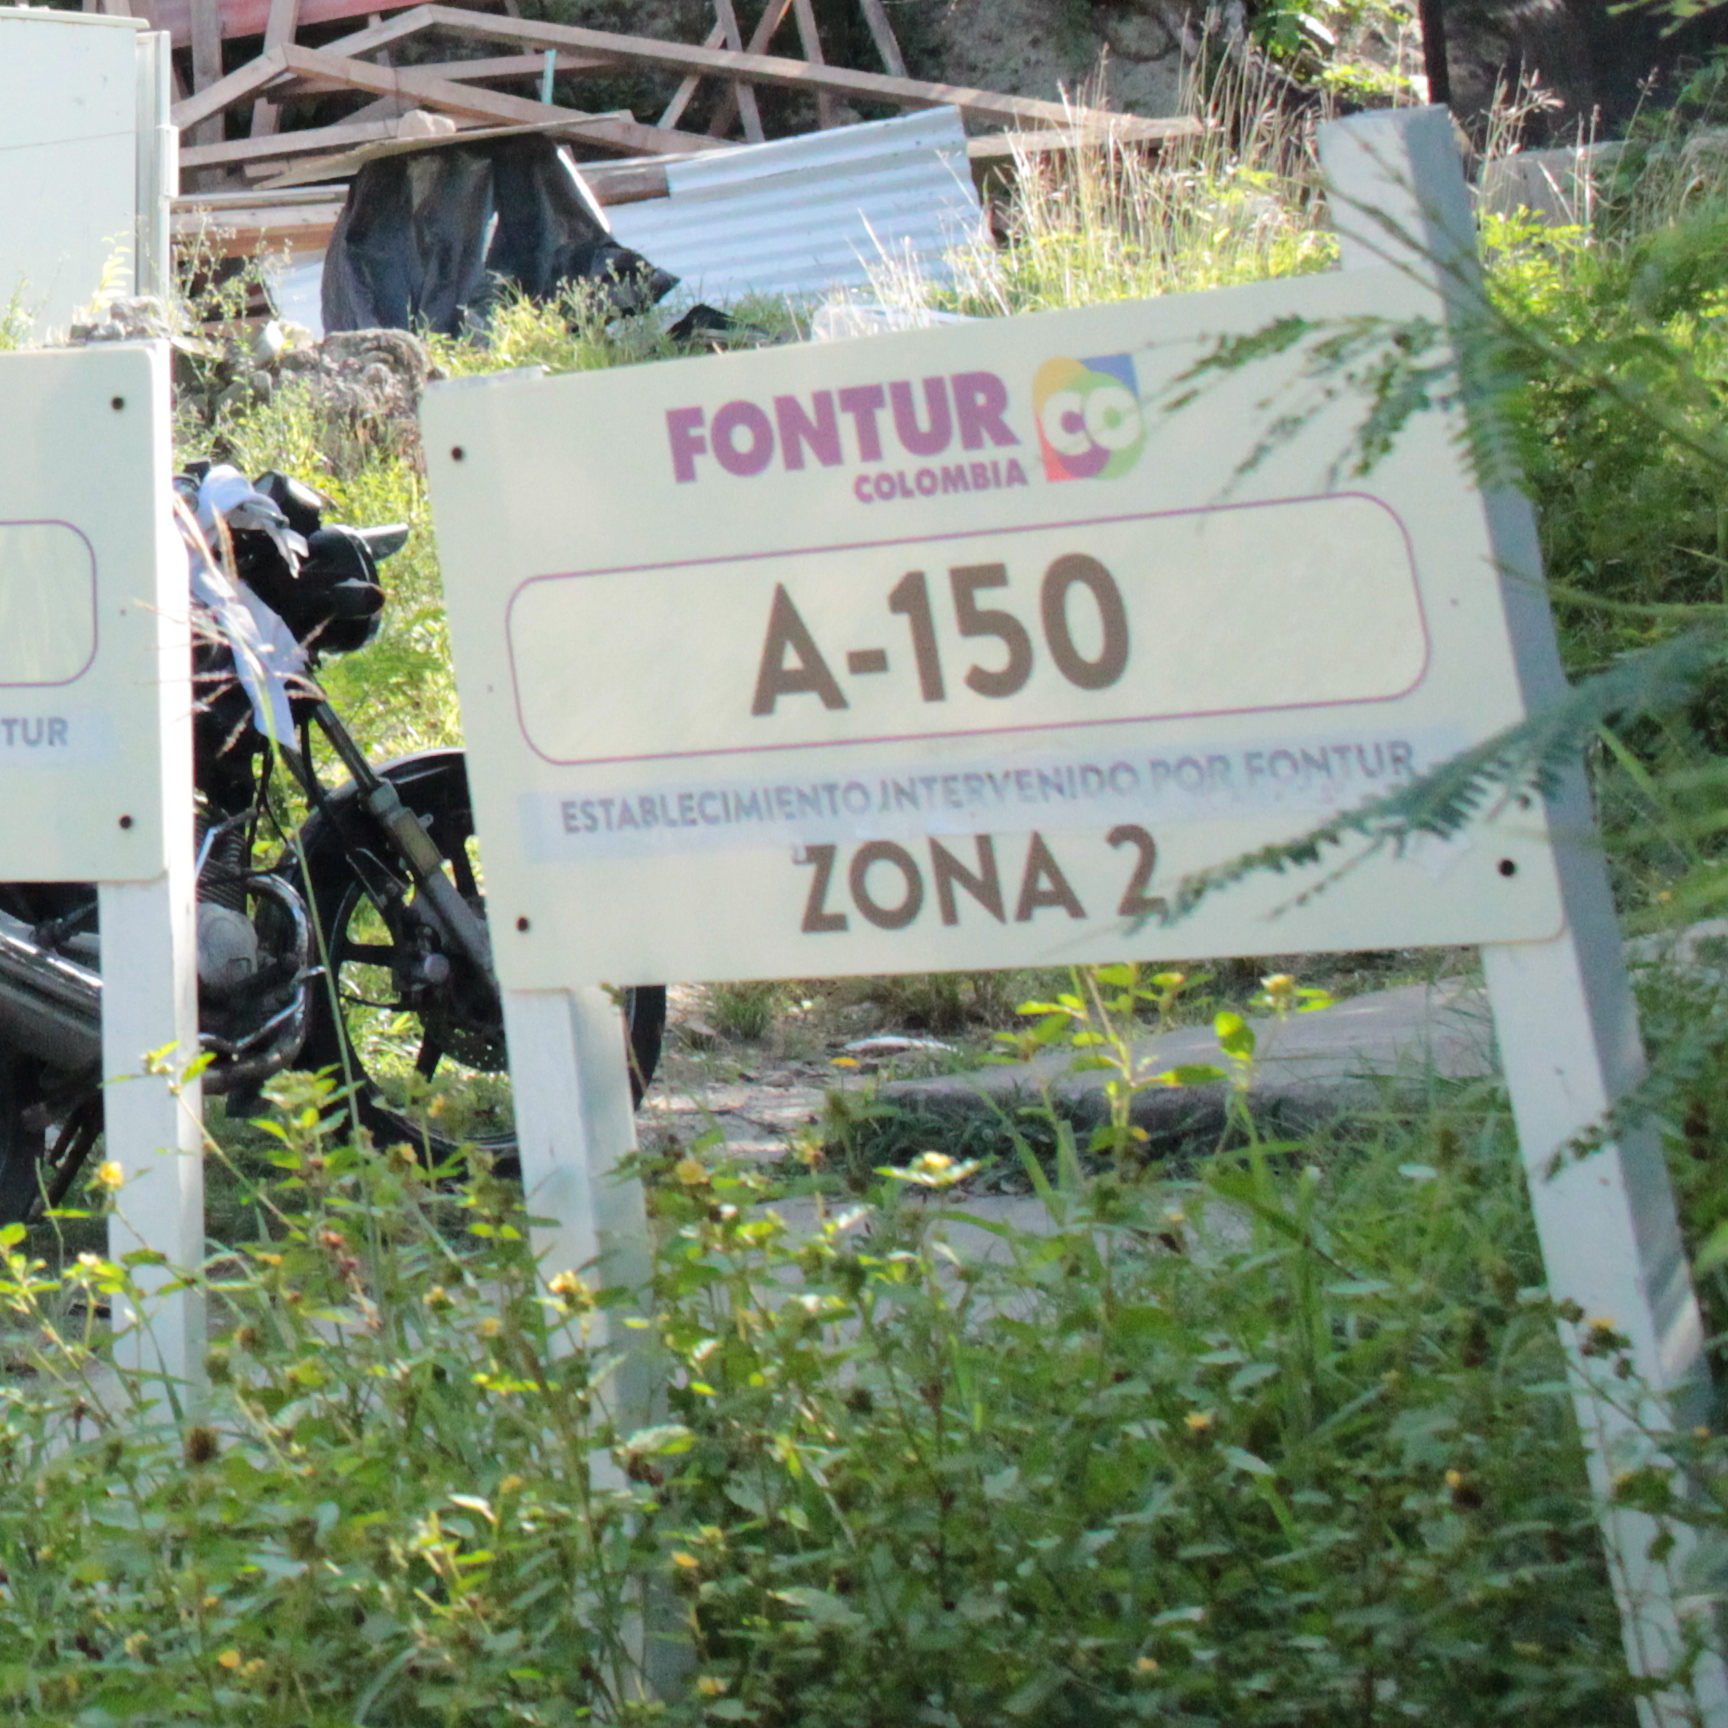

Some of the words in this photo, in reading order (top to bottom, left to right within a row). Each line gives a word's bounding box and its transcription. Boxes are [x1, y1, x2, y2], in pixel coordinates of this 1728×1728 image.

[665, 370, 1021, 484] FONTUR
[853, 458, 1028, 504] COLOMBIA
[750, 552, 1130, 716] A-150
[561, 781, 871, 834] ESTABLECIMIENTO
[877, 761, 1140, 813] INTERVENIDO
[1149, 754, 1231, 793] POR
[1244, 739, 1415, 781] FONTUR
[792, 830, 1089, 933] ZONA
[1105, 823, 1169, 918] 2
